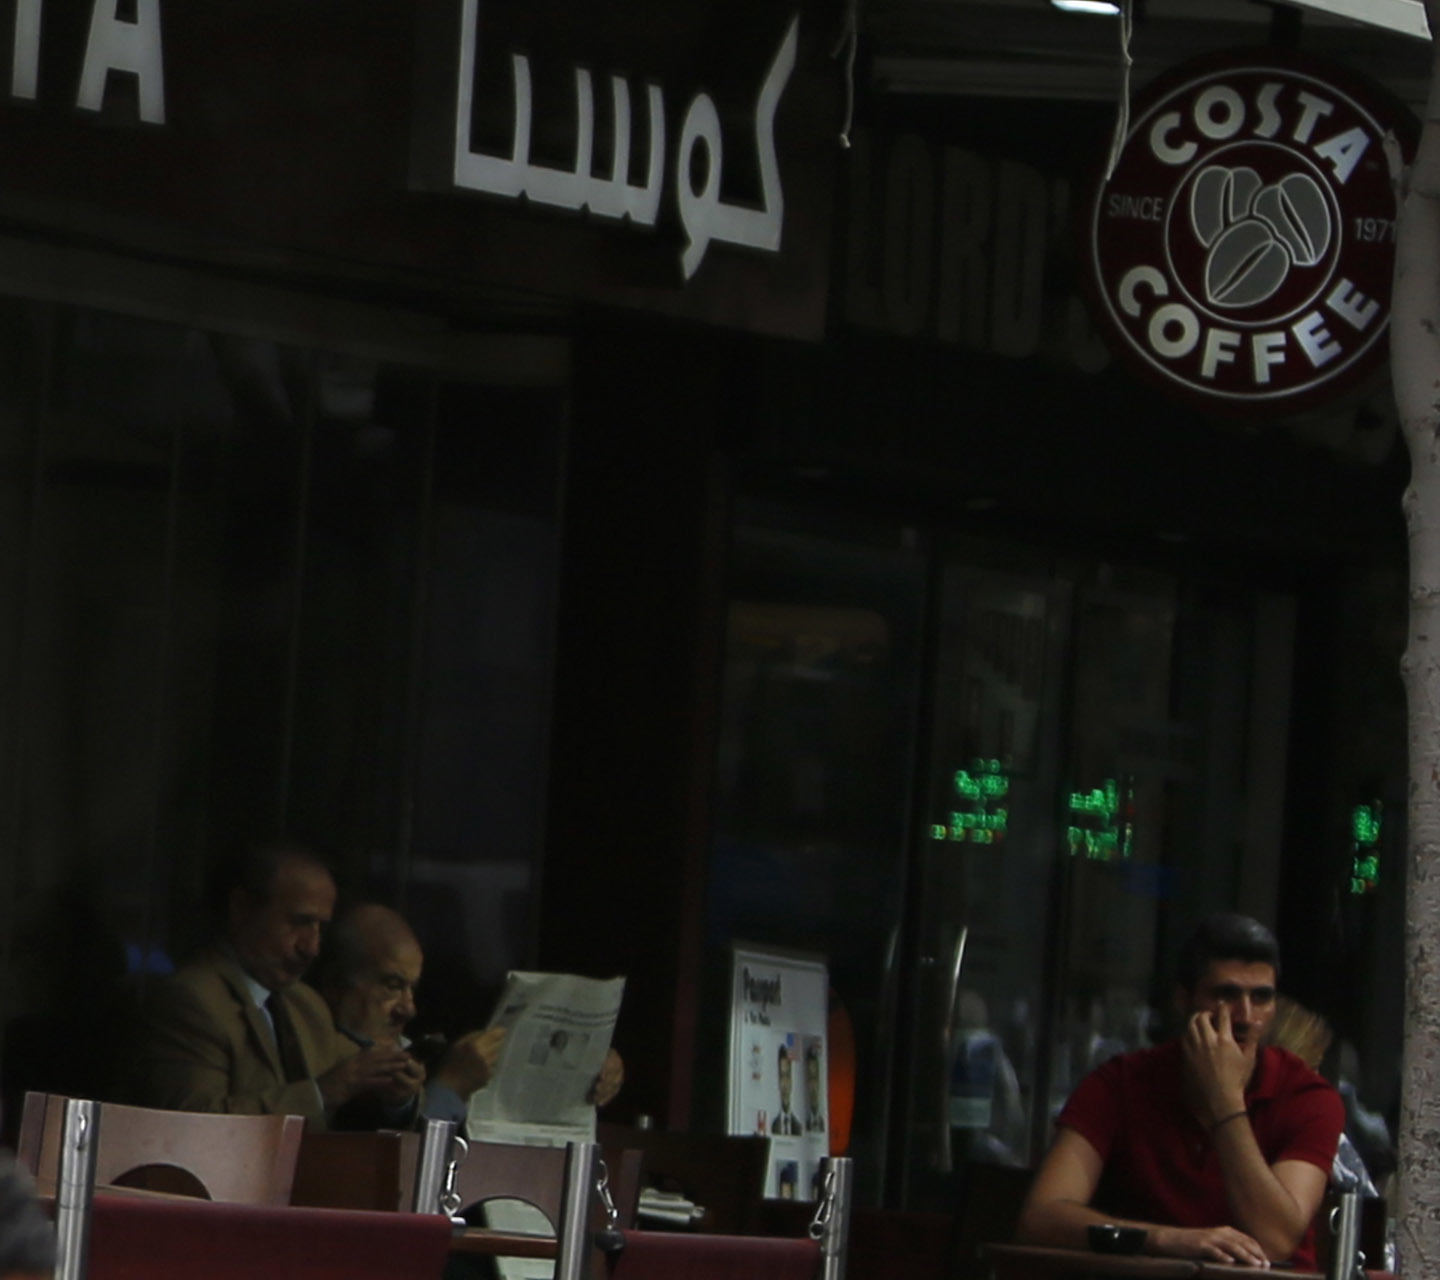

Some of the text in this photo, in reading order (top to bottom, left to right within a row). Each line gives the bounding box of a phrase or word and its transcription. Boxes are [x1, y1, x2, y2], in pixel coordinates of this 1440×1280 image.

[1148, 82, 1371, 184] COSTA
[1108, 193, 1165, 222] SINCE
[1354, 218, 1398, 243] 1971
[1118, 265, 1380, 384] COFFEE
